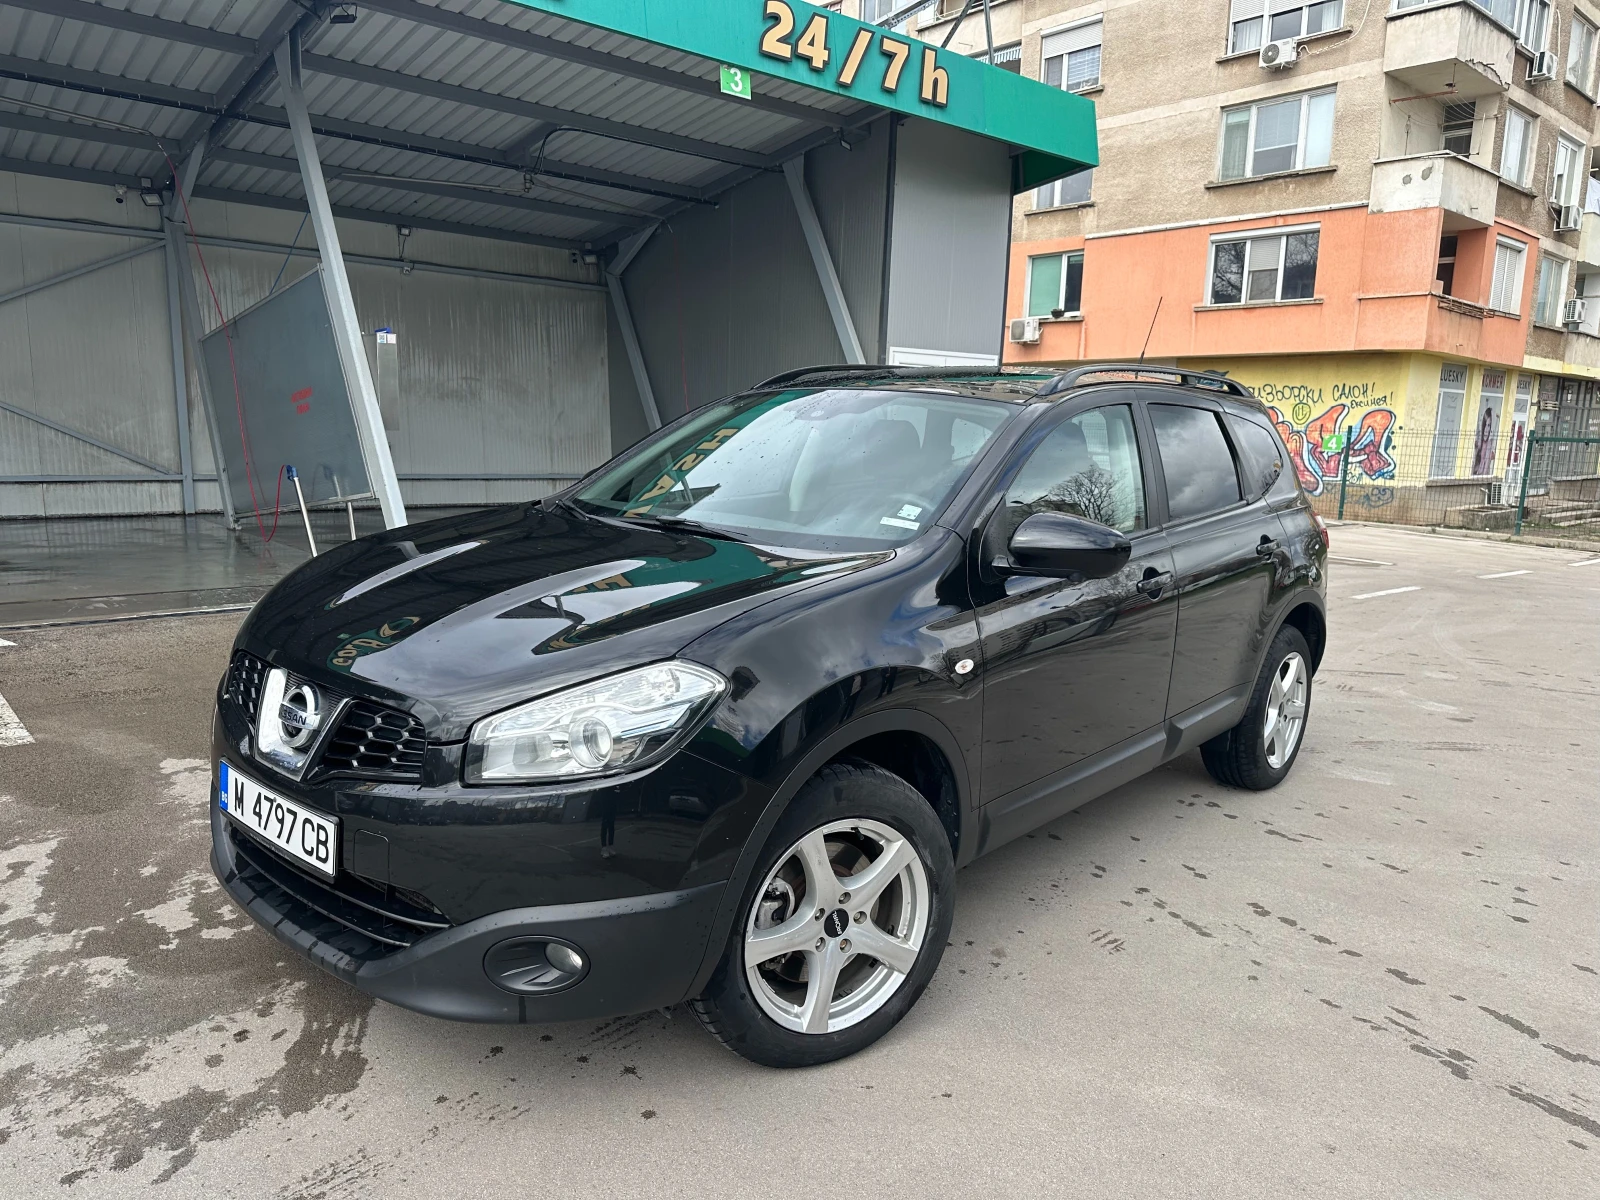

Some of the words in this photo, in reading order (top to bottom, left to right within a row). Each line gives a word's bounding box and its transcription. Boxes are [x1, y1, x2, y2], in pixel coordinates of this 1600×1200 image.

[729, 67, 743, 92] 3
[1440, 368, 1464, 384] LUESKY
[1327, 436, 1338, 450] 4
[234, 777, 245, 817] M
[252, 791, 298, 845] 4797
[301, 817, 329, 864] CB
